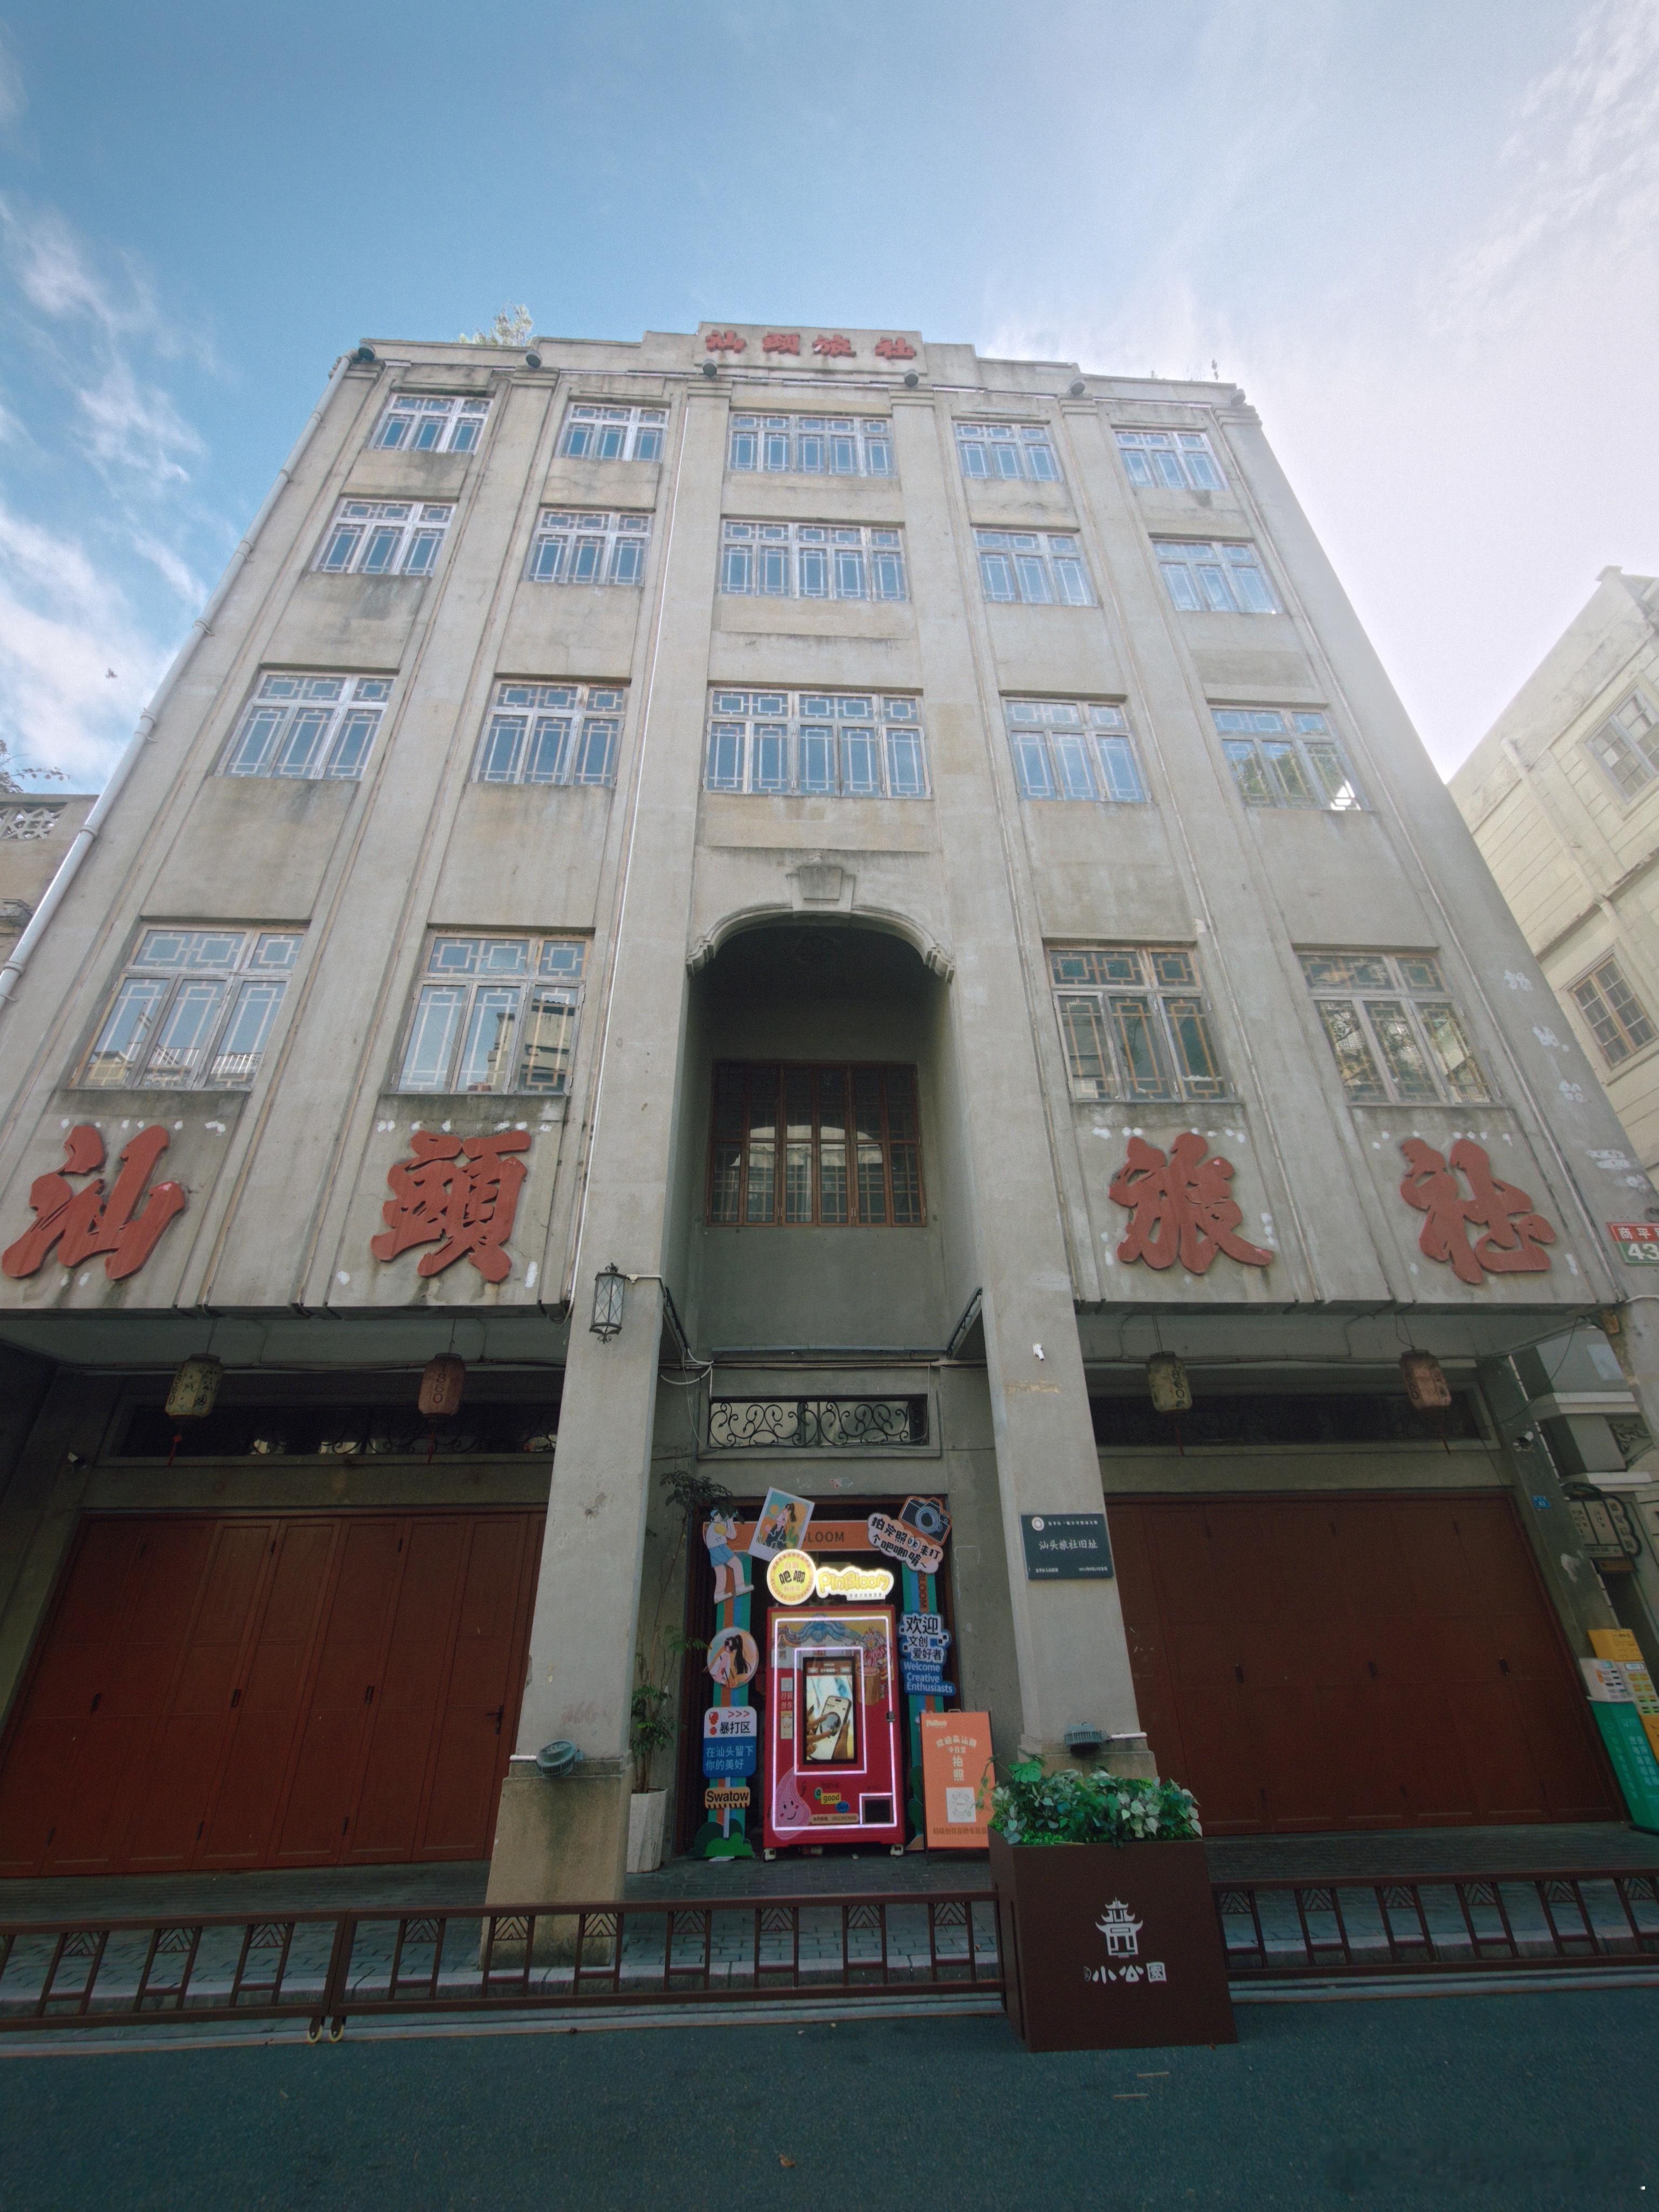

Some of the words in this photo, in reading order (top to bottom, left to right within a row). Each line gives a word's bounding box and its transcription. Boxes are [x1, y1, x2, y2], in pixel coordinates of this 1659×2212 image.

[705, 329, 917, 360] 汕頭旅社
[804, 1531, 845, 1543] LOOM
[871, 1516, 908, 1545] 拍完照
[920, 1544, 941, 1560] 来打
[1038, 1539, 1098, 1551] 汕头旅社旧址
[778, 1570, 806, 1585] 吧唧
[906, 1615, 939, 1635] 欢迎
[908, 1635, 928, 1647] 文创
[913, 1648, 942, 1661] 爱好者
[903, 1661, 940, 1672] Welcome
[907, 1672, 940, 1683] Creative
[907, 1681, 953, 1693] Enthusiasts
[720, 1721, 751, 1735] 暴打区
[706, 1745, 754, 1758] 在汕头留下
[706, 1759, 744, 1771] 你的美好
[706, 1790, 749, 1802] Swatow
[823, 1793, 839, 1803] good
